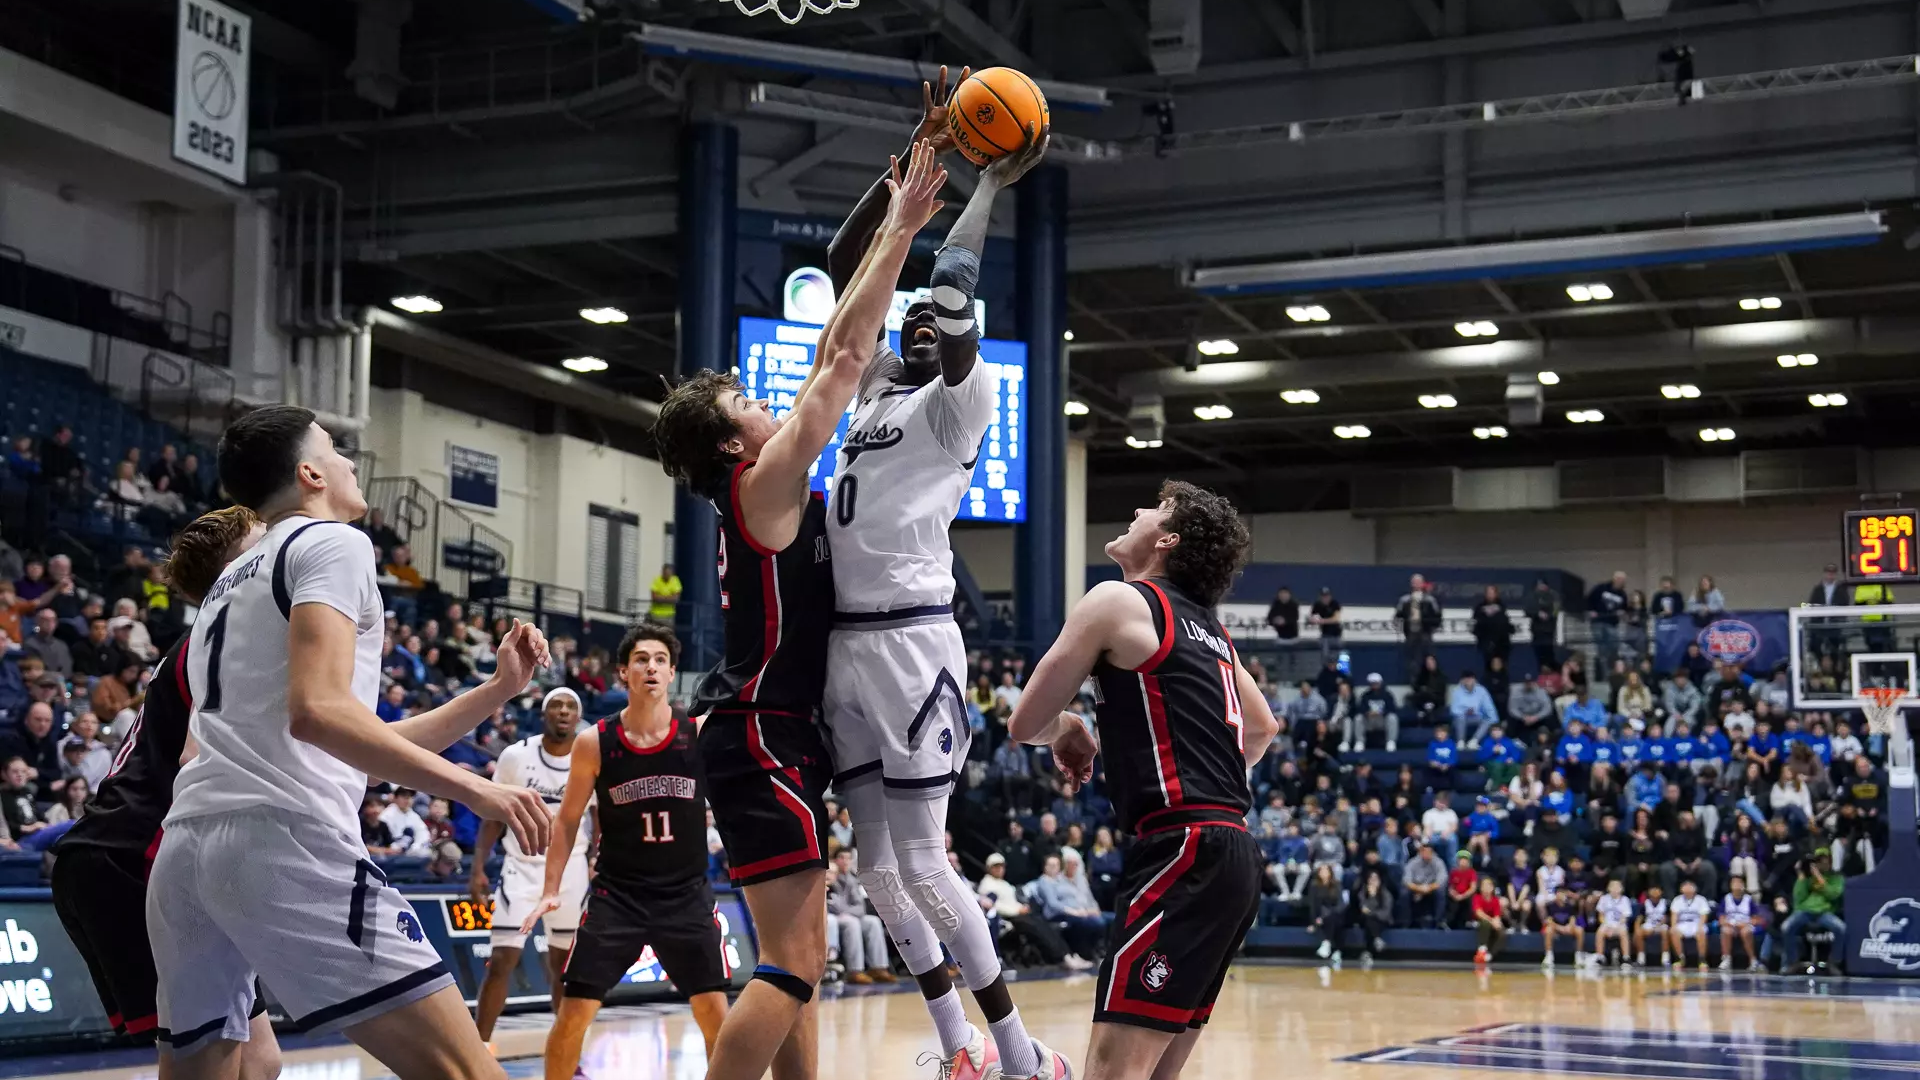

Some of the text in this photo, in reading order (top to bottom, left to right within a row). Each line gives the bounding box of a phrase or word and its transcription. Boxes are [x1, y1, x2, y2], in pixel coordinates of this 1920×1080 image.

[187, 2, 243, 56] NCAA
[188, 120, 235, 165] 2023
[949, 107, 994, 161] Wilson
[837, 472, 858, 528] 0
[1860, 516, 1913, 539] 13:59
[1860, 538, 1909, 575] 21
[198, 600, 232, 713] 1
[1217, 658, 1245, 754] 4
[608, 775, 697, 805] NORTHEASTERN
[641, 811, 675, 842] 11
[452, 901, 496, 931] 13:5
